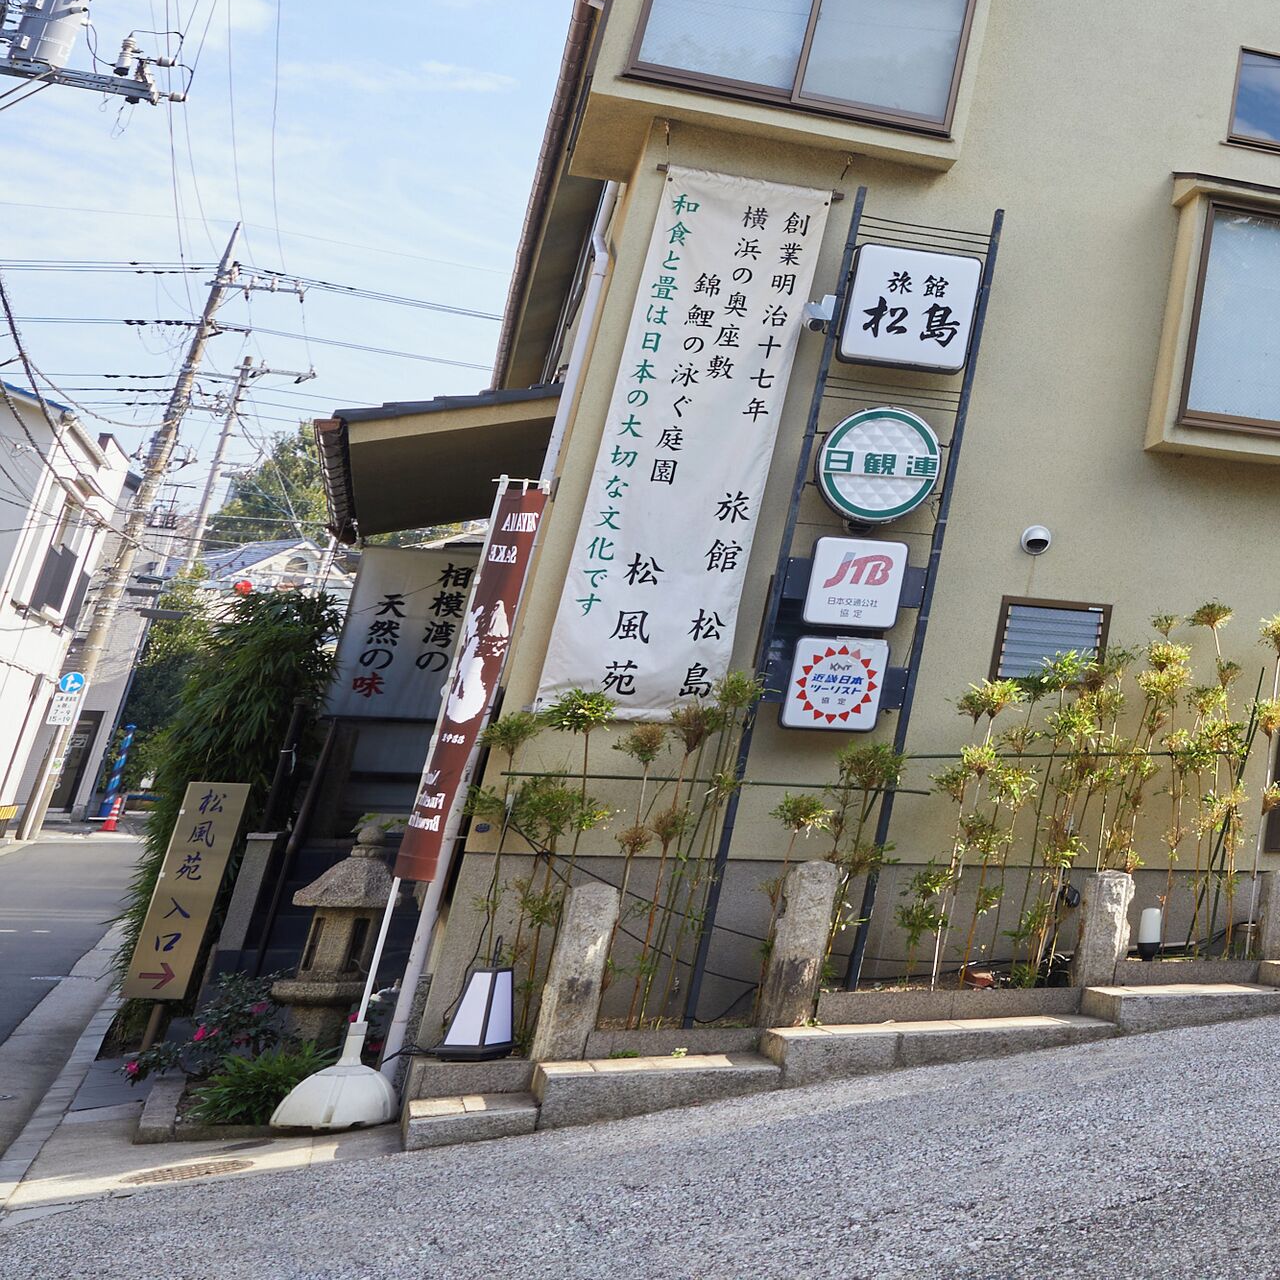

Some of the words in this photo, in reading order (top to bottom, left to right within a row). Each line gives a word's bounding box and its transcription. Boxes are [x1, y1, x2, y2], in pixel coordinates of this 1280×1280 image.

[706, 205, 769, 379] 横浜の奥座敷
[887, 271, 949, 298] 旅館
[742, 211, 811, 423] 創業明治十七年
[862, 295, 960, 348] 松島
[575, 193, 701, 617] 和食と畳は日本の大切な文化です
[650, 272, 721, 485] 錦鯉の泳ぐ庭園
[824, 449, 938, 478] 日観連
[822, 551, 894, 589] JTB
[415, 563, 474, 673] 相模湾の
[601, 552, 664, 696] 松風苑
[827, 596, 878, 608] 日本交通公社
[840, 609, 863, 618] 協定
[352, 593, 407, 698] 天然の味
[829, 662, 852, 671] KNT
[810, 684, 862, 696] ツーリスト
[812, 673, 864, 685] 近畿日本
[821, 697, 847, 706] 協定
[175, 788, 227, 881] 松風苑
[154, 897, 191, 952] 入口
